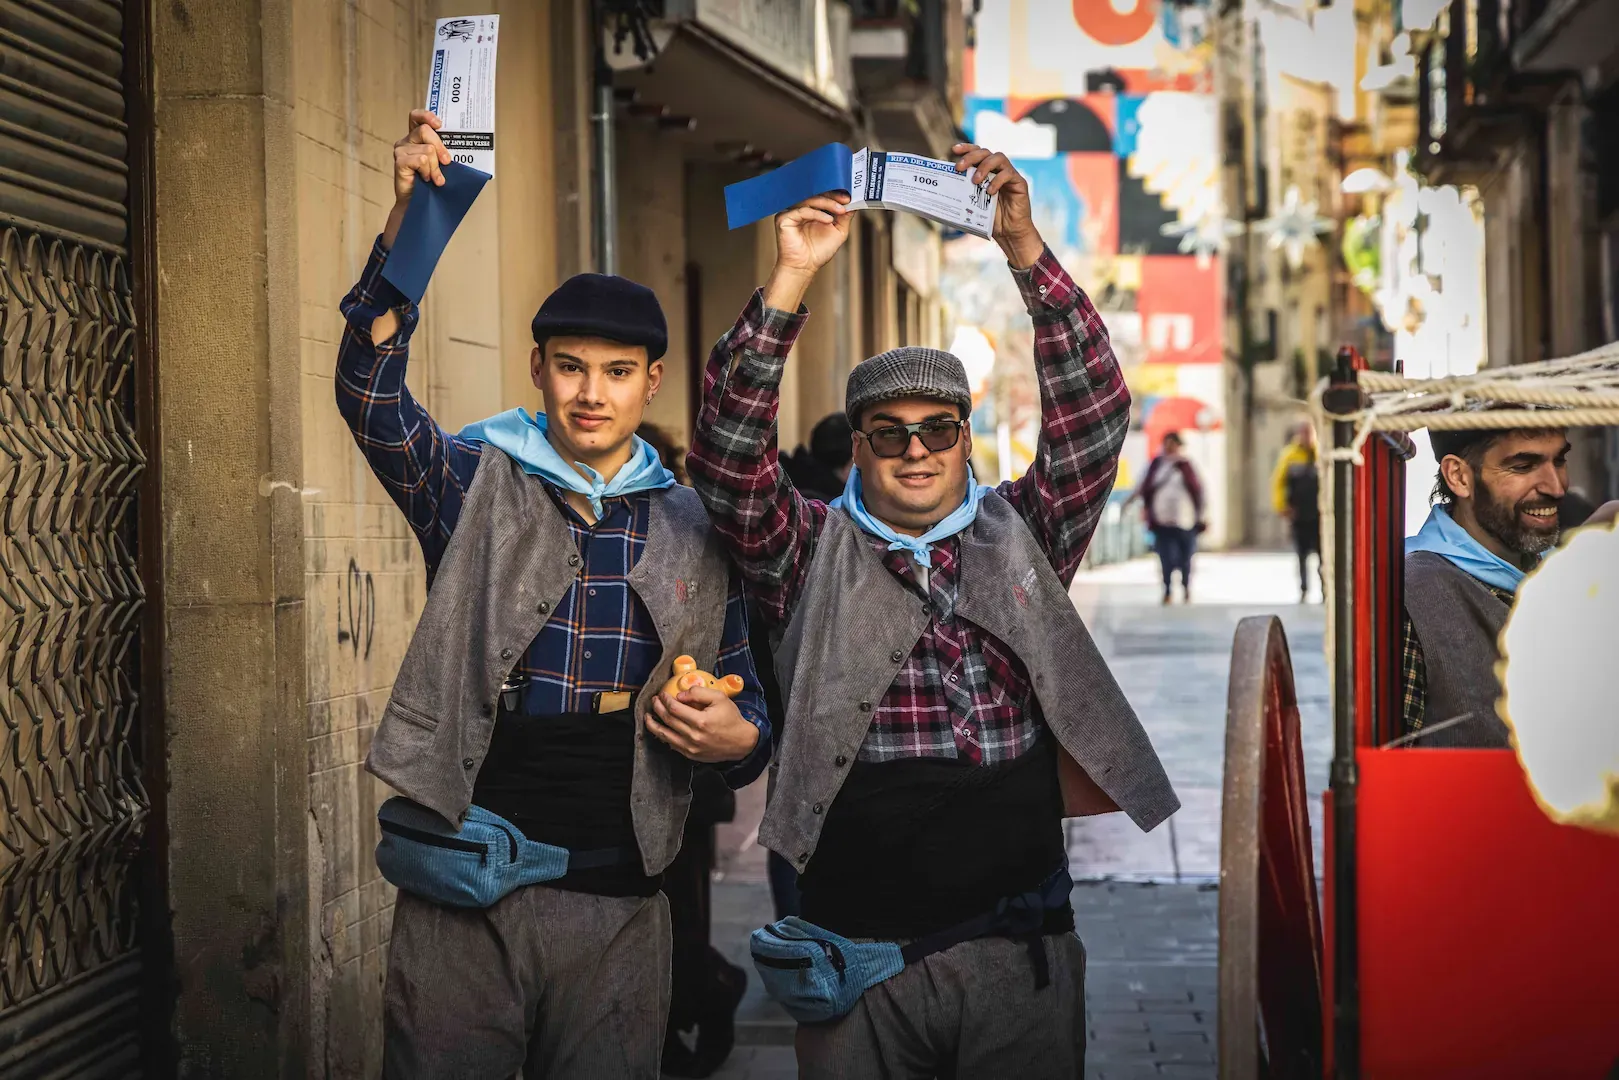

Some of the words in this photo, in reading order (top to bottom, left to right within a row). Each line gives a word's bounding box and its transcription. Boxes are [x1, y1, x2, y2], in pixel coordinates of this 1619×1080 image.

[433, 54, 443, 91] PORQUET
[451, 76, 462, 103] 0002
[430, 91, 439, 107] DEL
[453, 154, 474, 164] 000
[890, 155, 909, 163] RIFA
[910, 158, 925, 166] DEL
[853, 170, 863, 189] 1001
[913, 175, 939, 187] 1006
